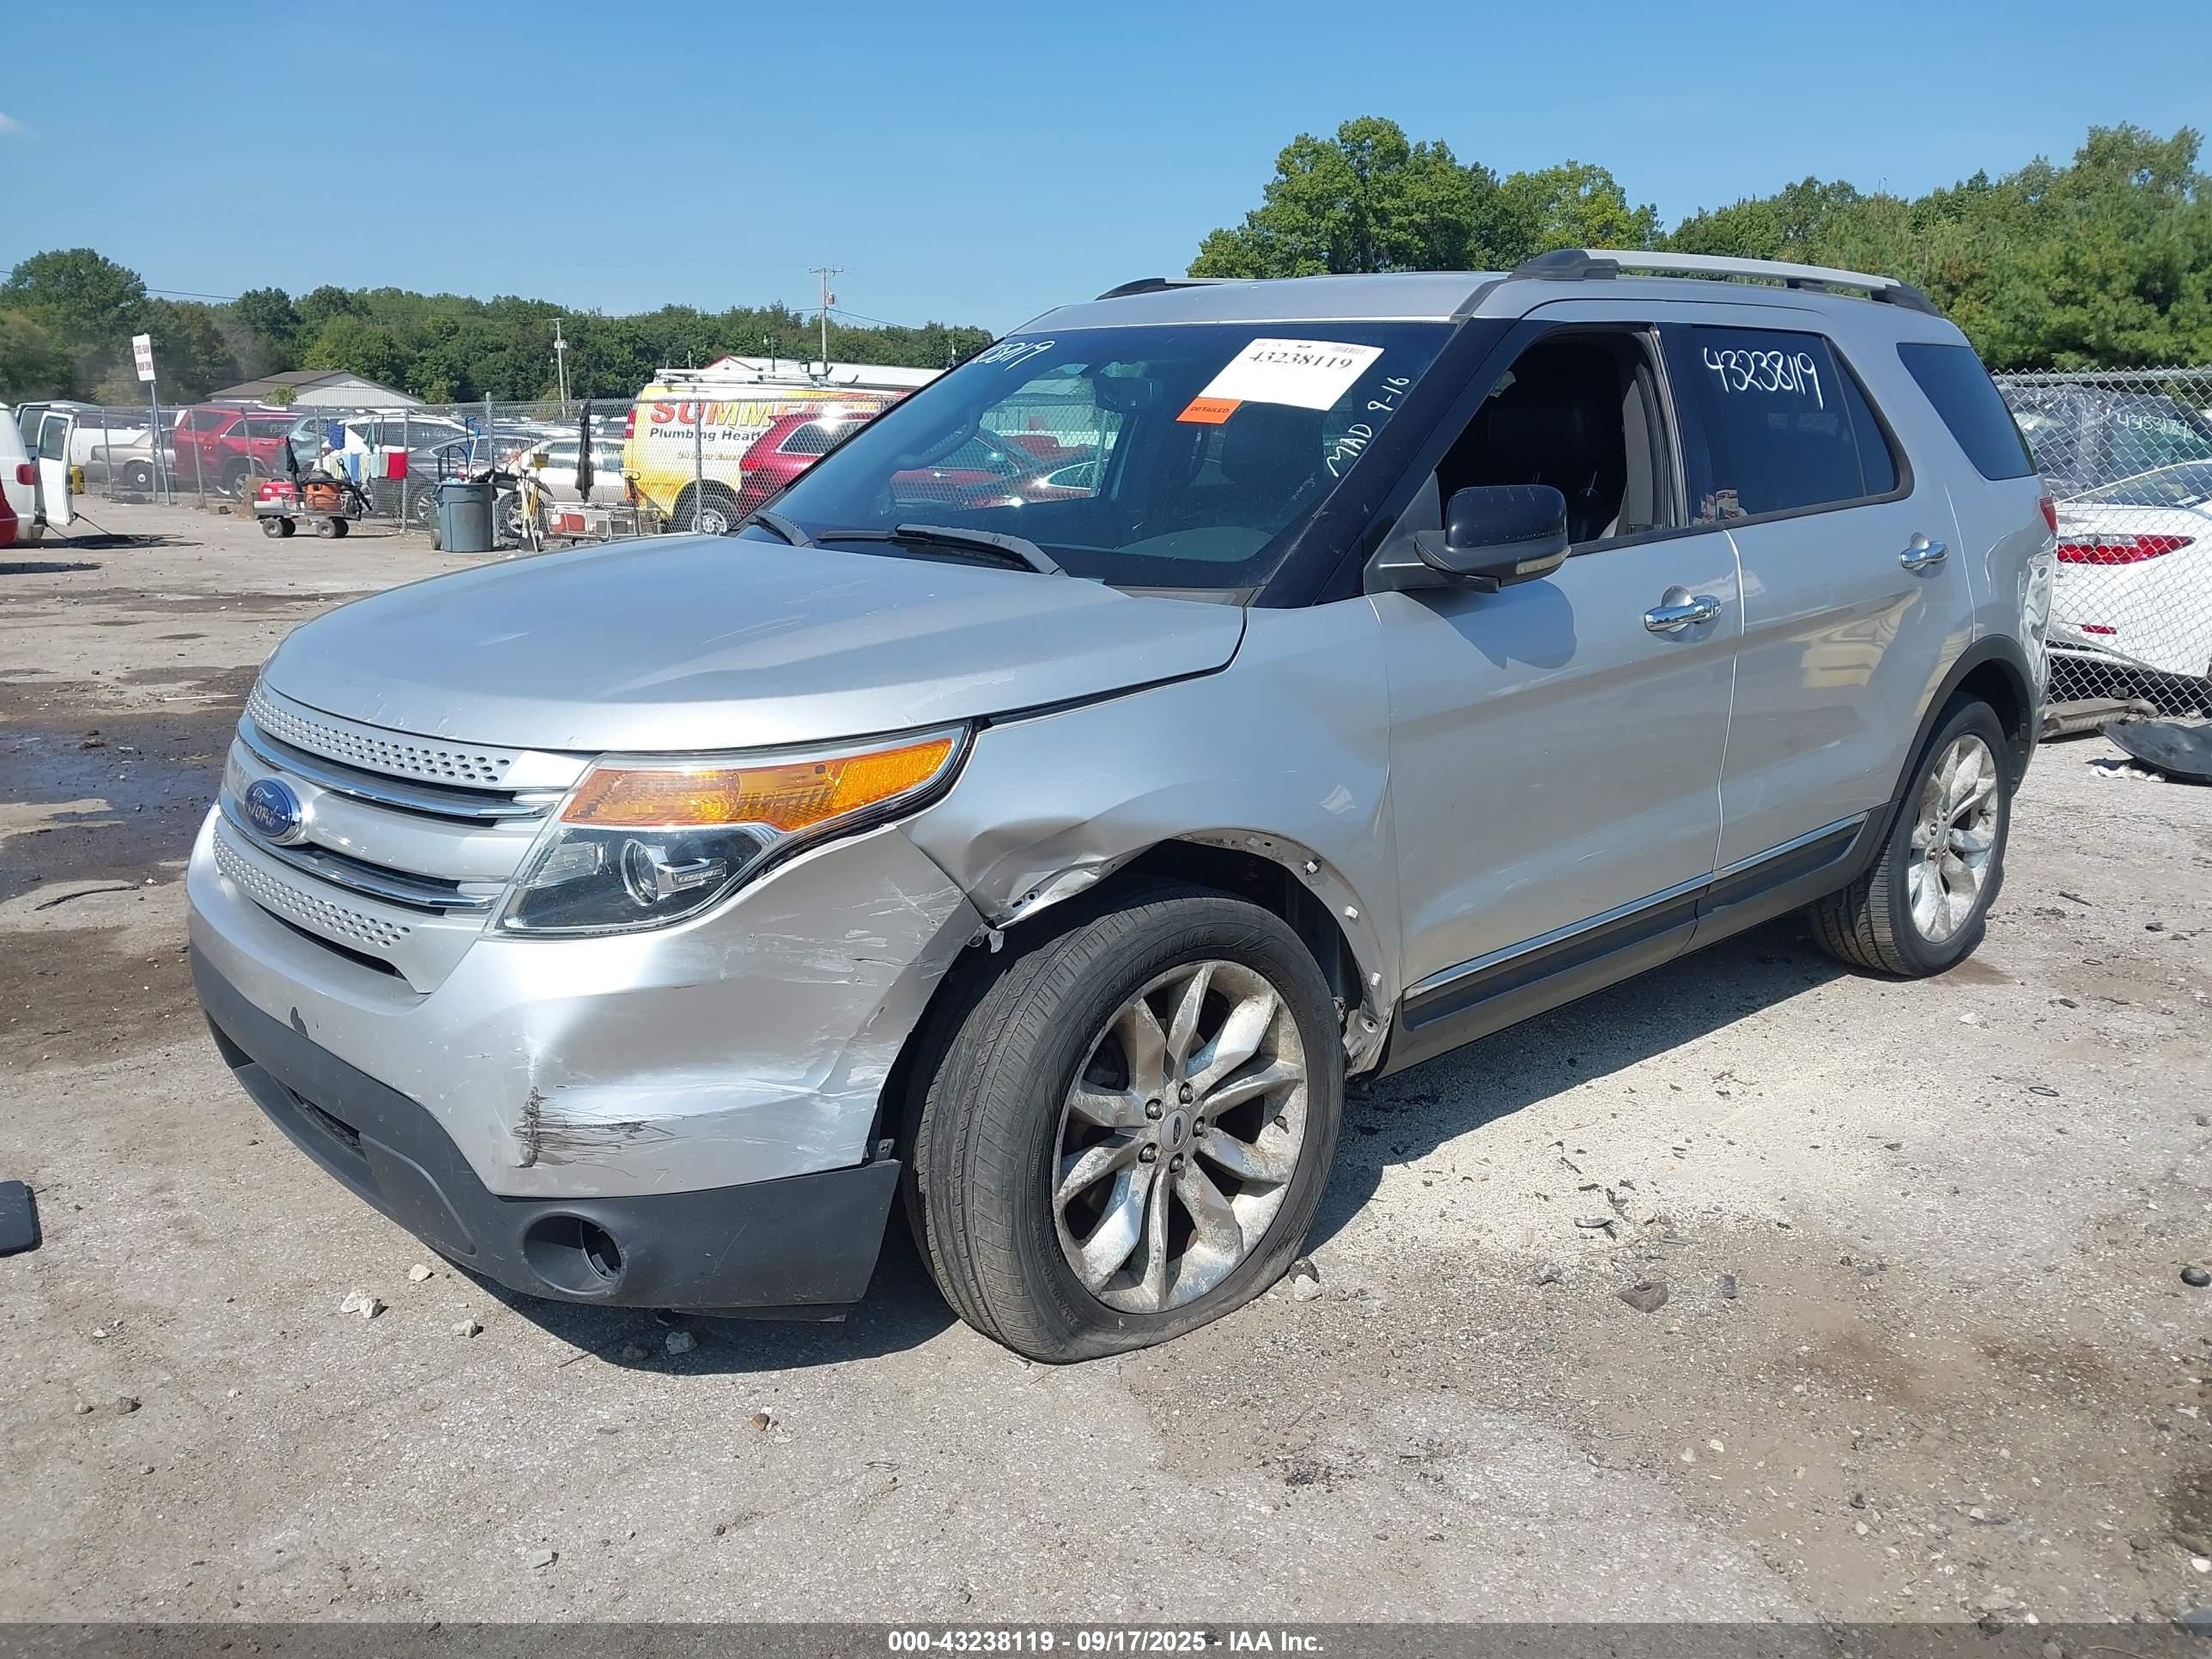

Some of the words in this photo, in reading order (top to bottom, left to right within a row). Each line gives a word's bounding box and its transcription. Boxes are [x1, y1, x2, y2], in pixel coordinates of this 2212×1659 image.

[1249, 350, 1353, 370] 43238119
[1705, 347, 1824, 411] 43238119
[650, 399, 842, 428] SUMME
[1190, 405, 1230, 415] DETAILED
[649, 428, 717, 441] Plumbng
[1326, 423, 1372, 477] MAD
[1367, 376, 1410, 411] 9-16
[250, 787, 289, 828] Ford
